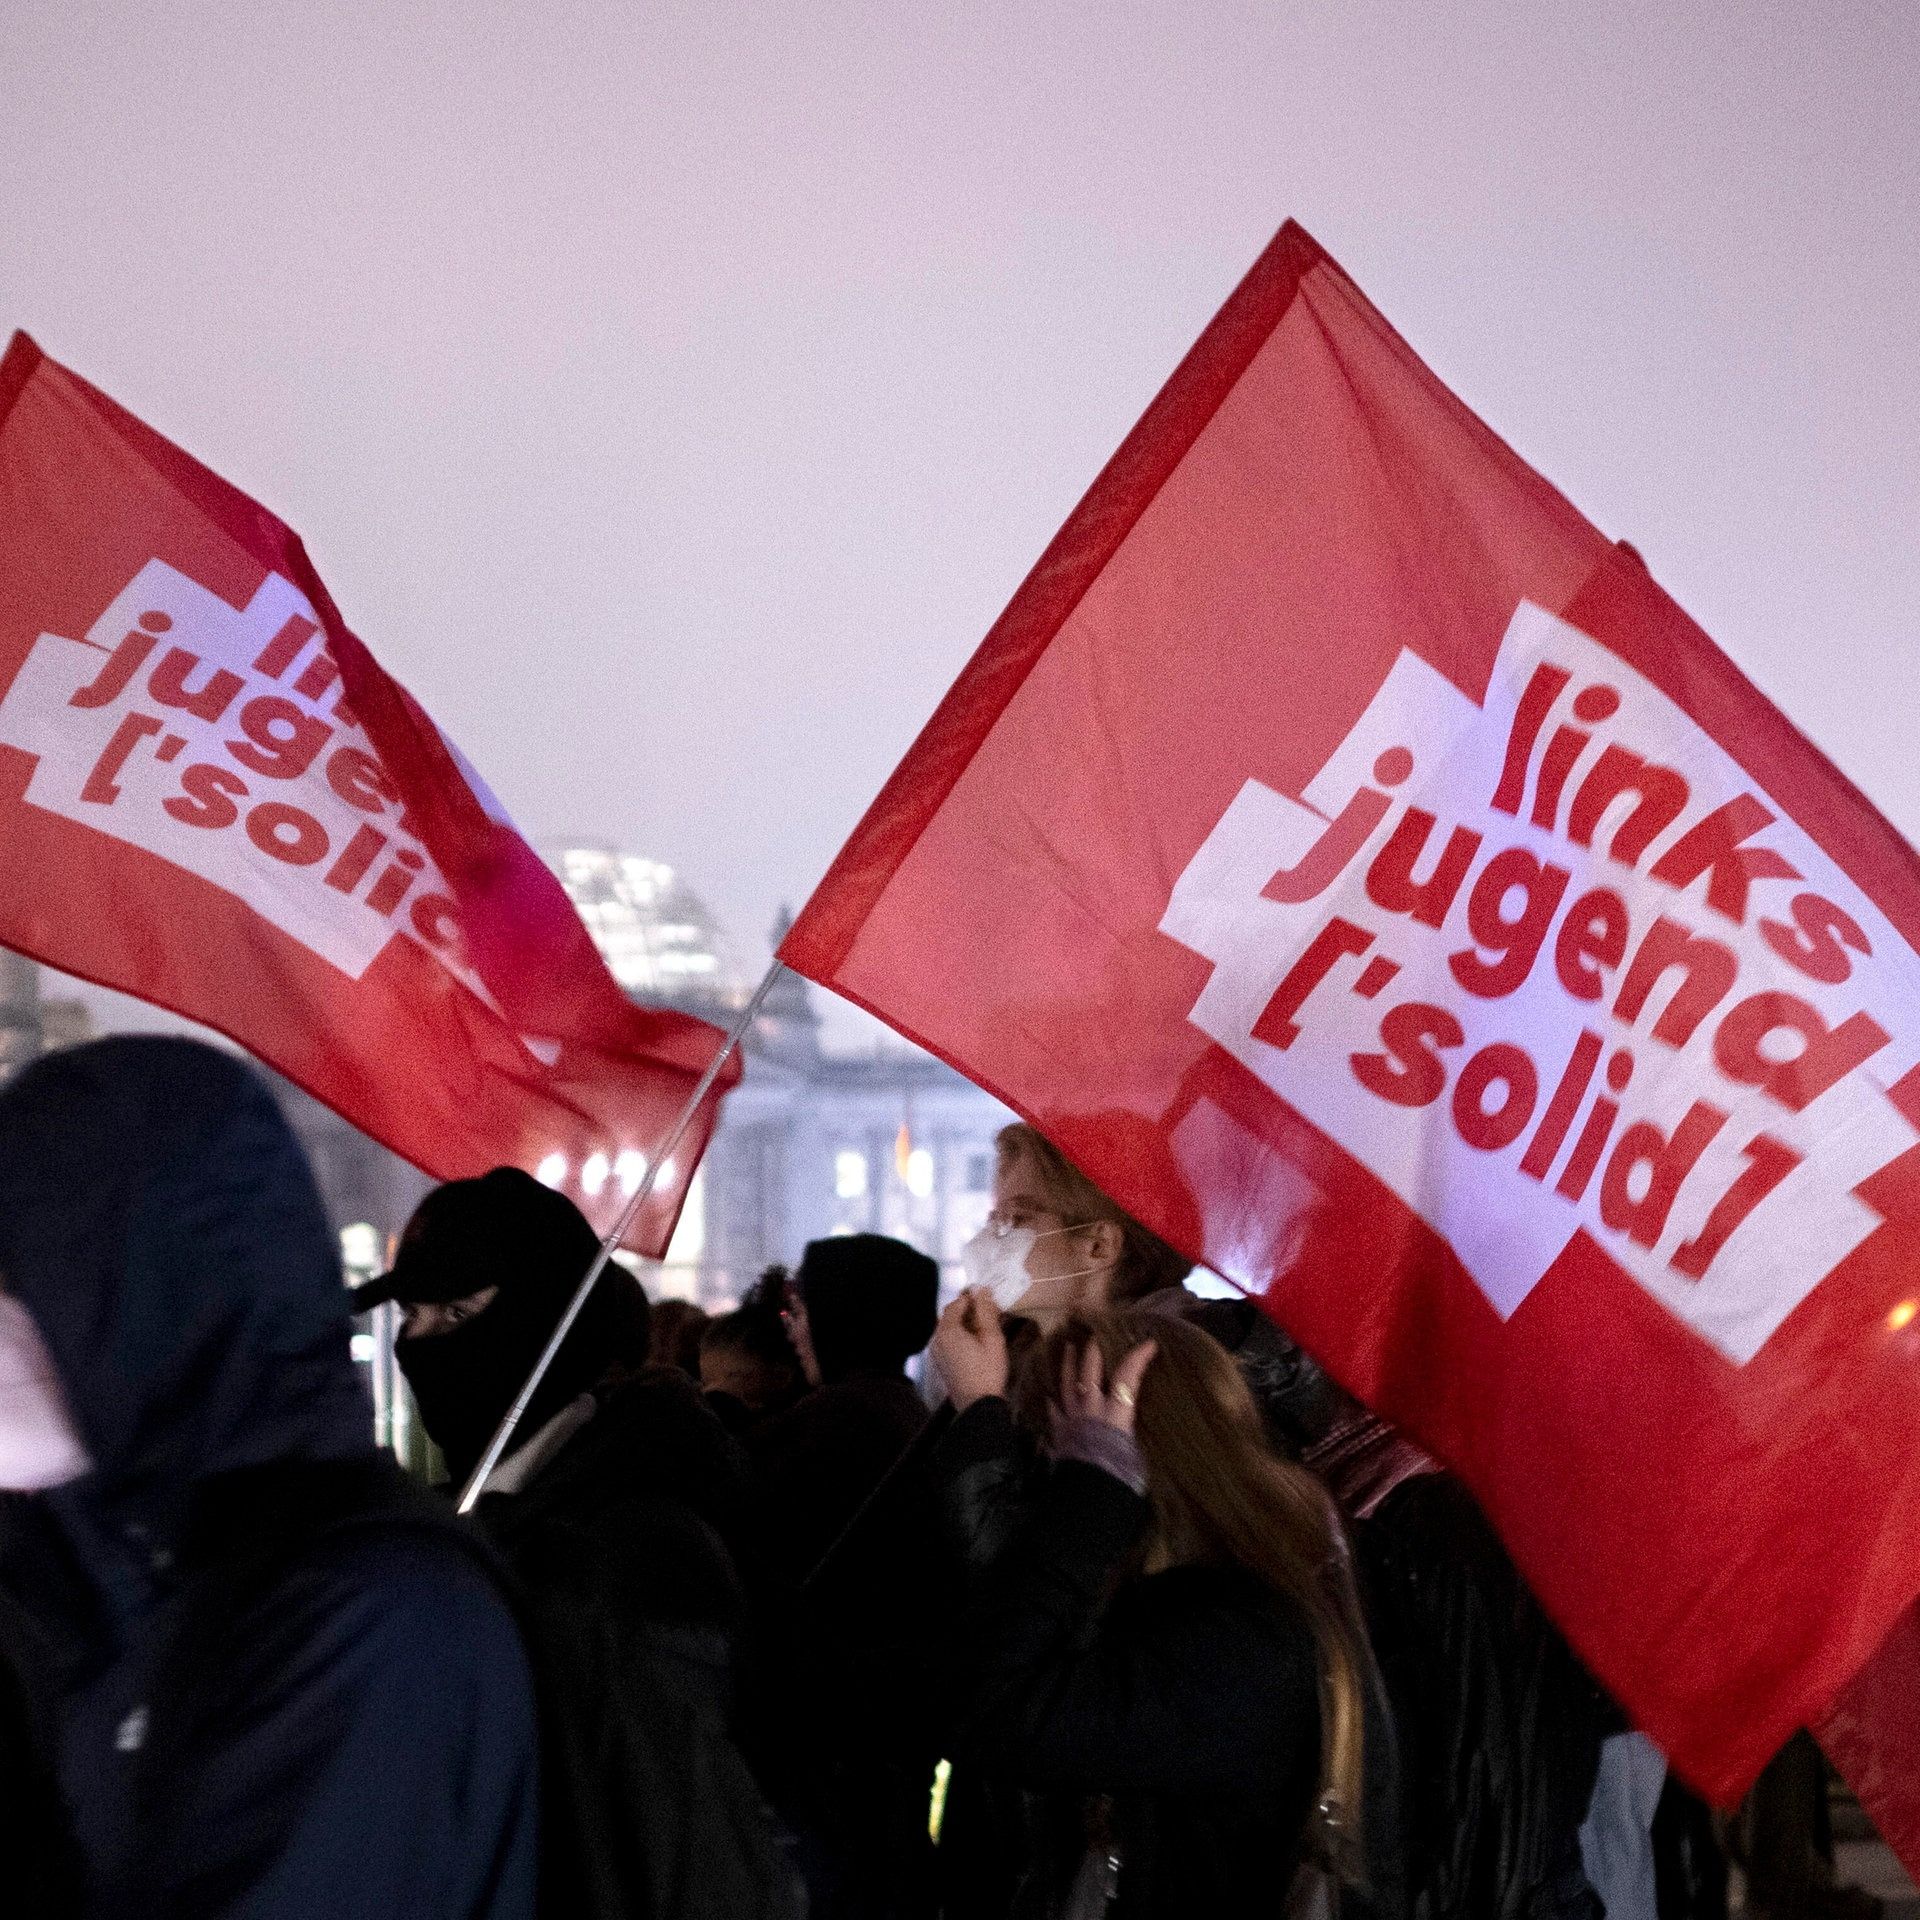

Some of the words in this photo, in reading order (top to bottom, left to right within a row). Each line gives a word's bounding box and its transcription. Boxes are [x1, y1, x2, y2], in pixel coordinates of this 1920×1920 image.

[67, 611, 404, 813] juge
[1490, 661, 1873, 985] links
[1259, 746, 1892, 1114] jugend
